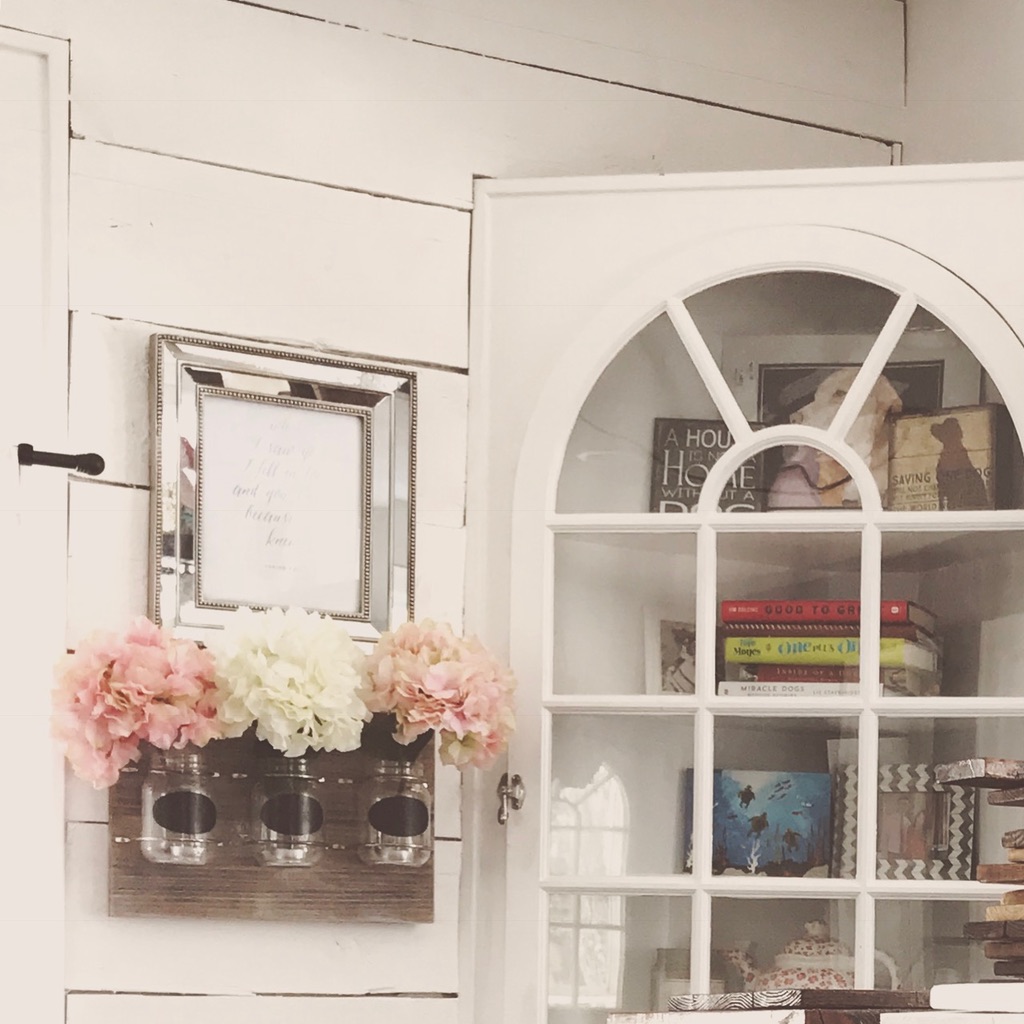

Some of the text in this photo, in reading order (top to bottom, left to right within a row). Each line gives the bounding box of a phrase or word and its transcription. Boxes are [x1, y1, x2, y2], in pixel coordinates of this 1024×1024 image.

[664, 428, 731, 448] A HOU
[662, 450, 756, 489] HOE
[892, 472, 931, 485] SAVING
[662, 487, 755, 501] WITHUT A
[764, 605, 803, 615] GOOD
[812, 605, 830, 615] TO
